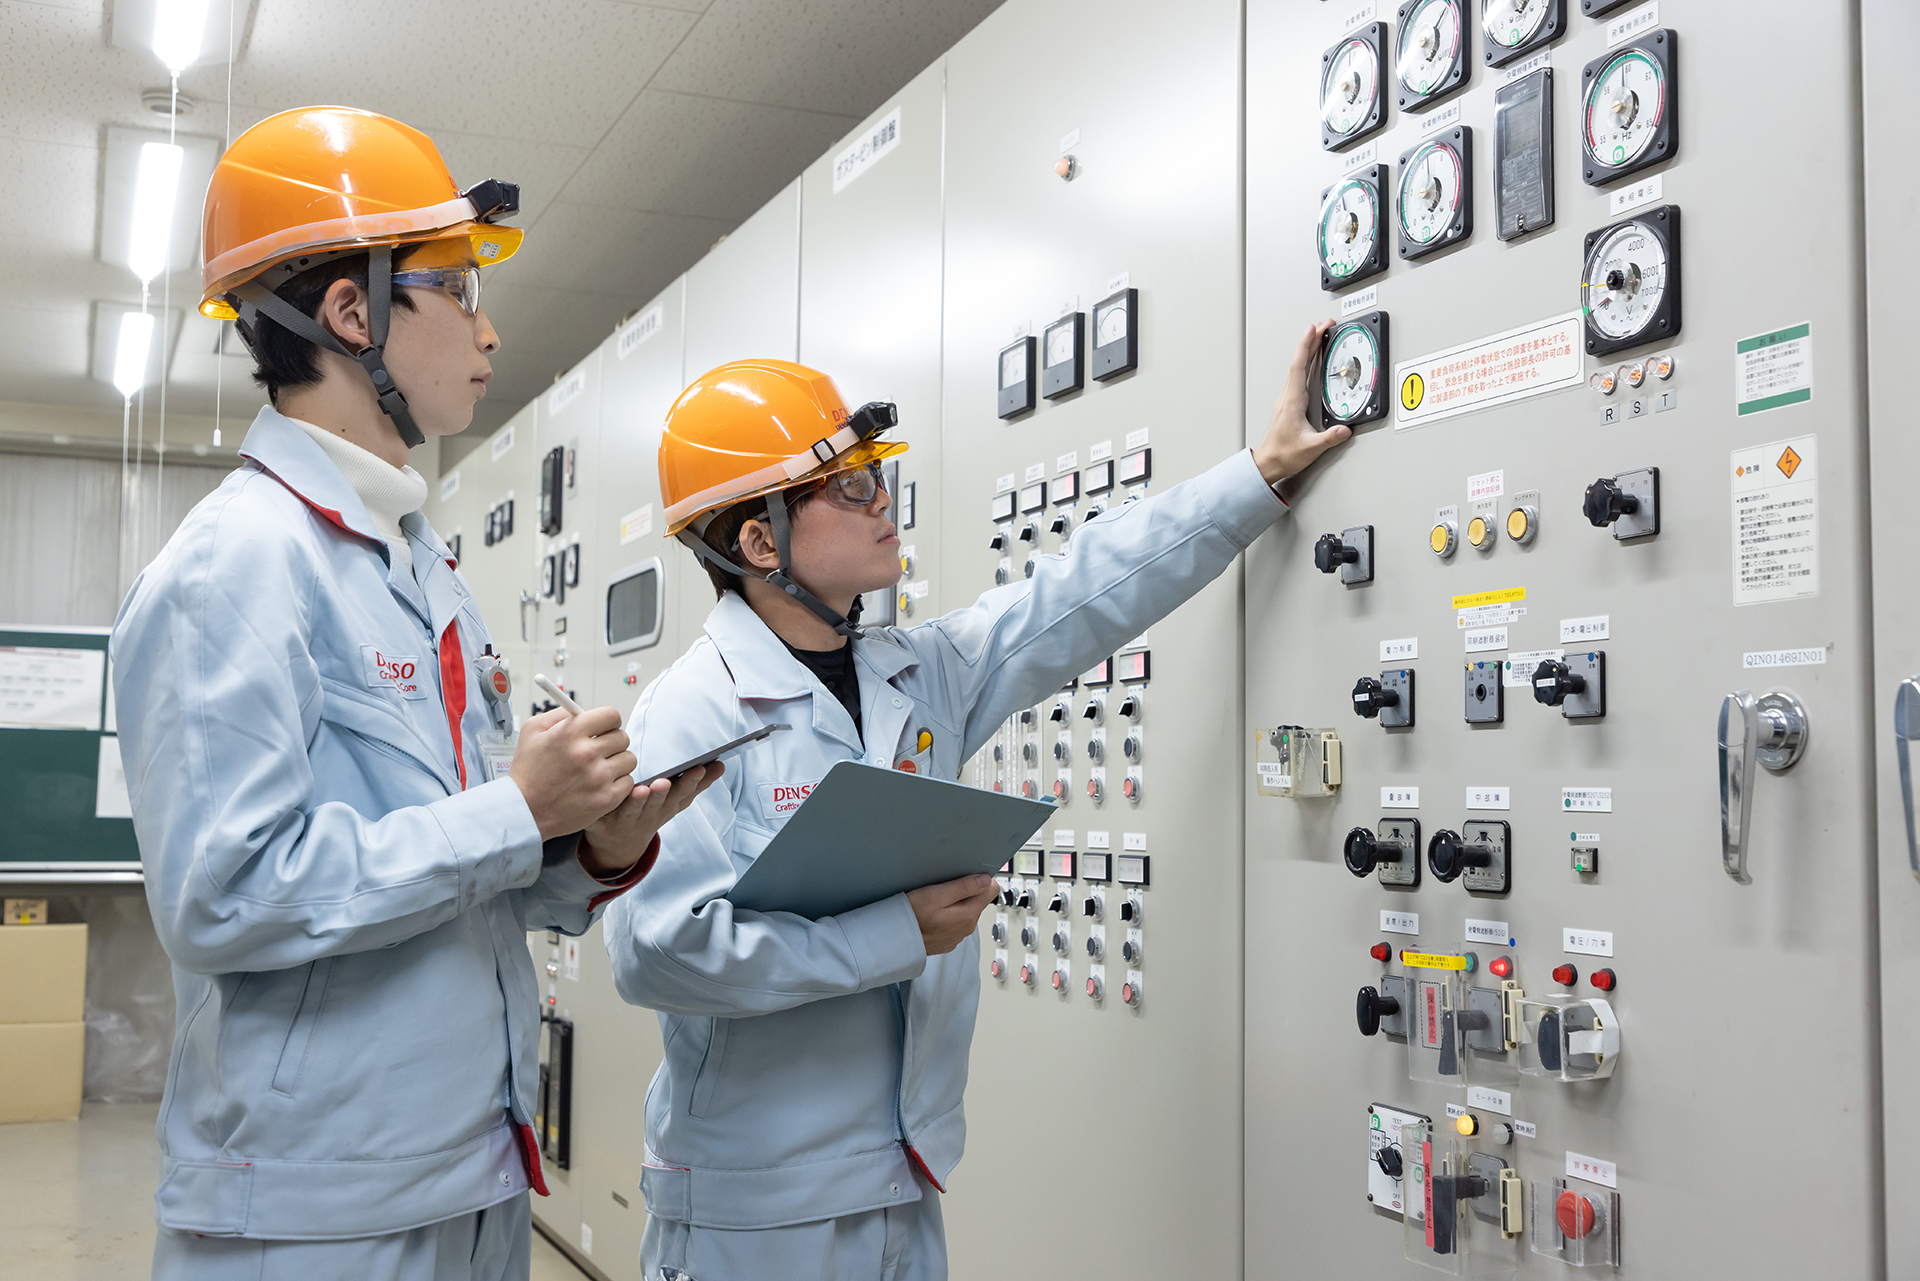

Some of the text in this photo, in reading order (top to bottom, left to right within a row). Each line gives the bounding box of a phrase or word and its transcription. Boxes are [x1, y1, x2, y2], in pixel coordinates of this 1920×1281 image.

[1621, 131, 1633, 142] Hz
[837, 119, 896, 181] ガスタービン制御盤
[1429, 213, 1435, 222] A
[1627, 237, 1645, 252] 4000
[1642, 268, 1660, 280] 6000
[1625, 304, 1634, 316] V
[1758, 333, 1787, 347] お願い
[1429, 331, 1570, 380] 重要負荷系統は停電状態での調査を基本とする。
[1661, 393, 1669, 407] T
[1633, 400, 1641, 414] S
[1605, 408, 1614, 421] R
[1745, 463, 1760, 475] 危険
[1470, 484, 1501, 497] 故障内容記録
[1514, 493, 1536, 502] ランプテスト
[1745, 650, 1823, 667] QIN01469IN01
[1573, 1160, 1608, 1178] 非常停止
